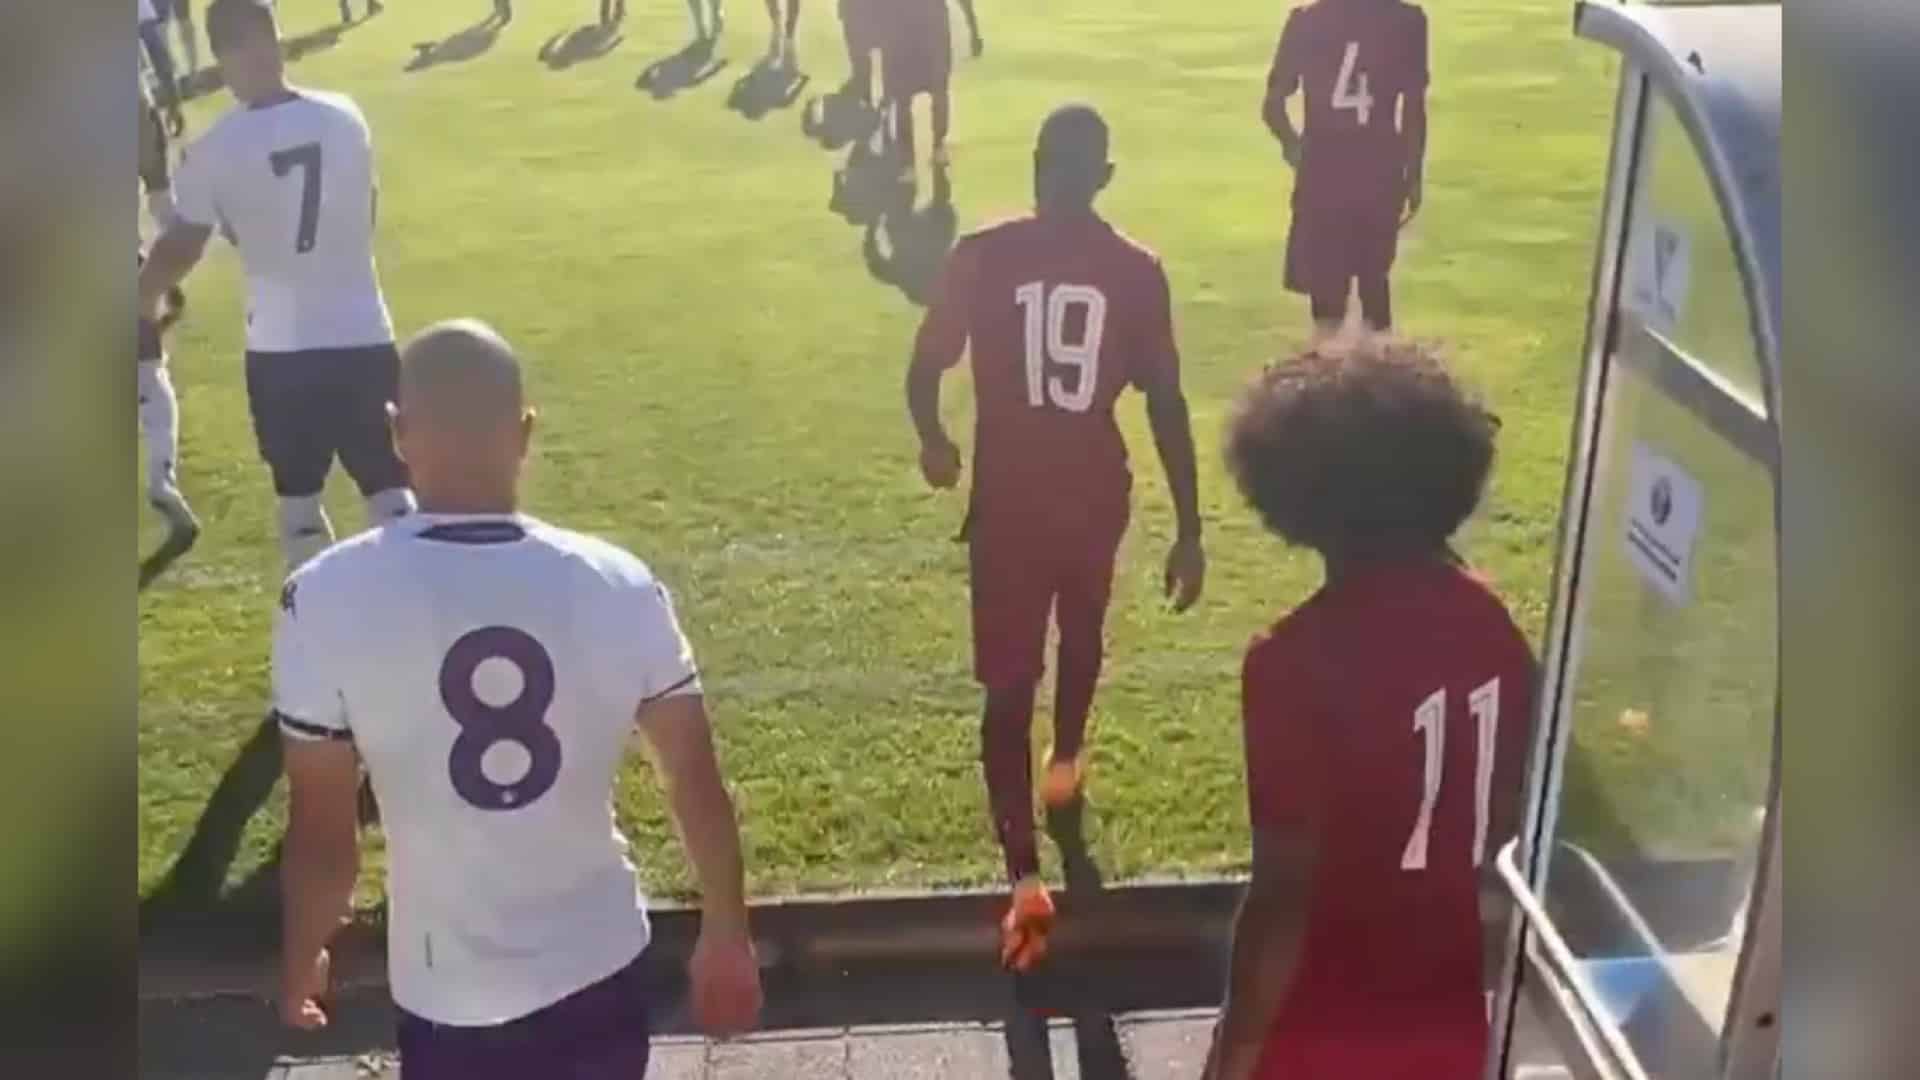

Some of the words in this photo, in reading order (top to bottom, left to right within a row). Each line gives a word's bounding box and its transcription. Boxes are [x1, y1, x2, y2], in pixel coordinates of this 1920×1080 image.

[1331, 42, 1375, 125] 4
[268, 142, 322, 253] 7
[1014, 281, 1107, 413] 19
[438, 625, 562, 811] 8
[1401, 676, 1501, 871] 11
